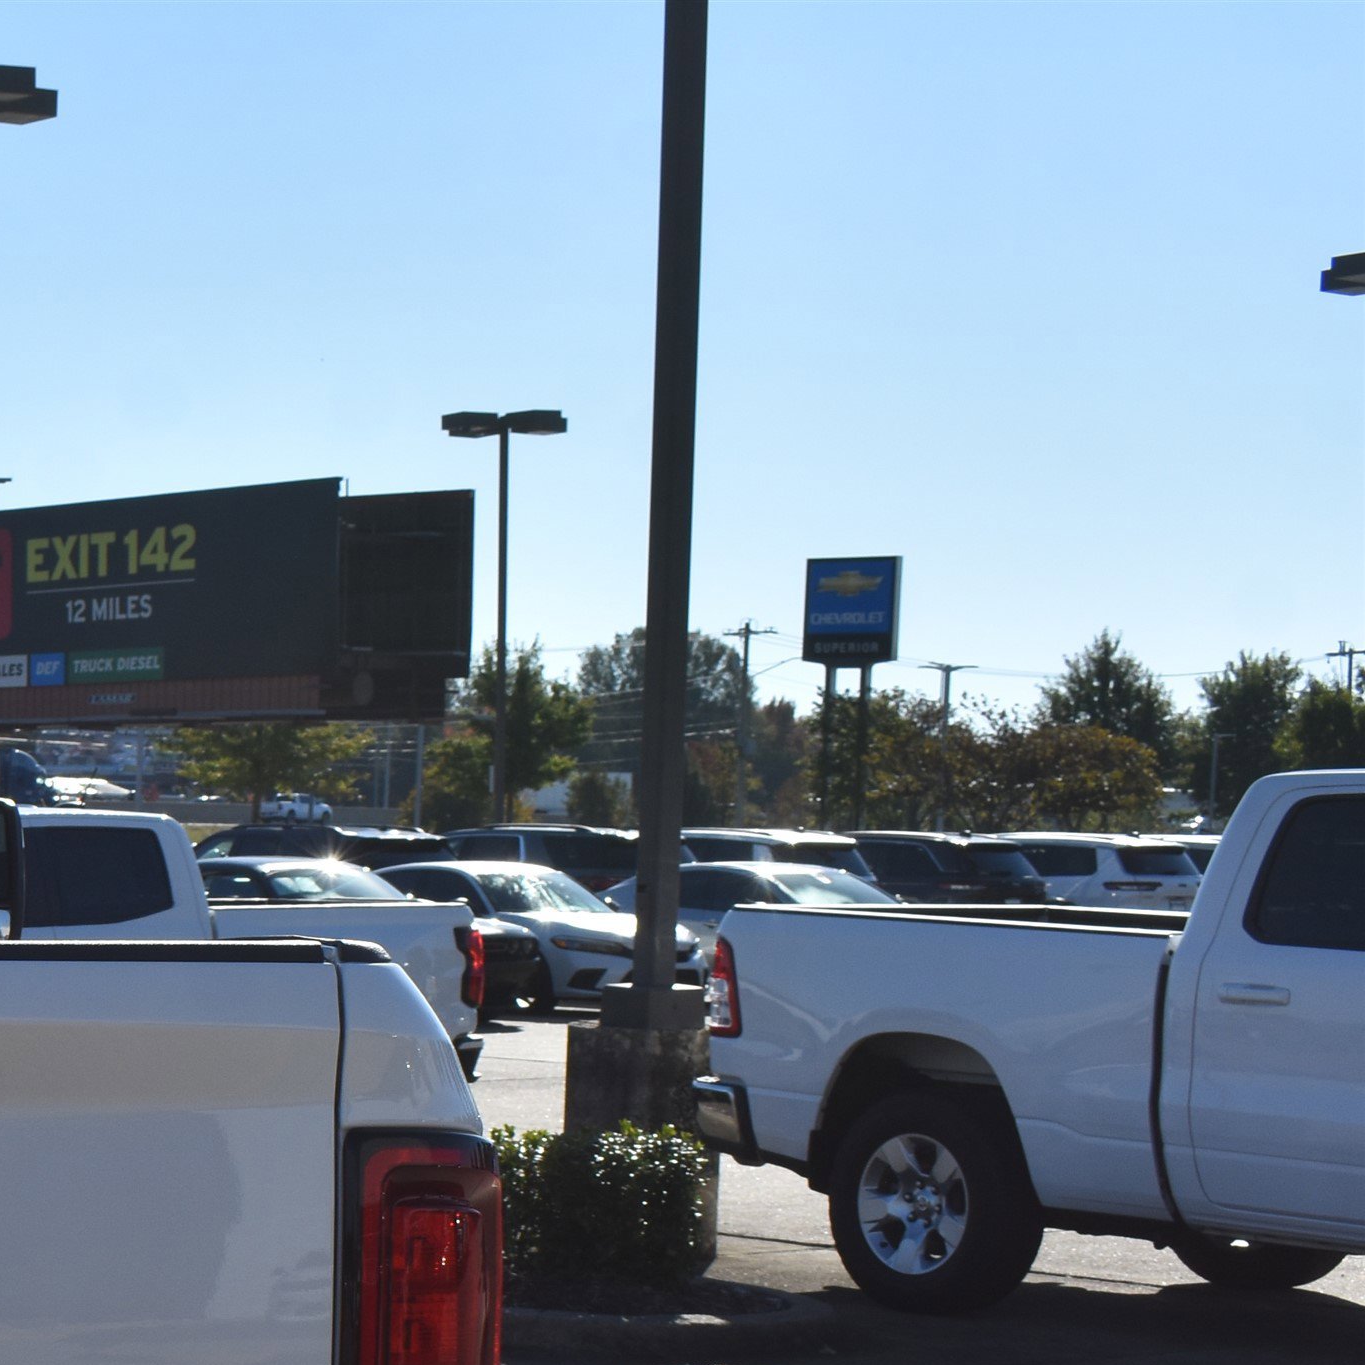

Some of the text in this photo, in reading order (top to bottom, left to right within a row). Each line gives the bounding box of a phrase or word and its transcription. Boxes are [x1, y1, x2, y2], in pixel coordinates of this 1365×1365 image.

[26, 523, 197, 583] EXIT 142
[66, 594, 152, 623] 12 MILES
[810, 611, 886, 625] CHEVROLET
[814, 641, 879, 654] SUPERIOR
[35, 660, 61, 676] DEF
[72, 655, 160, 674] TRUCK DIESEL
